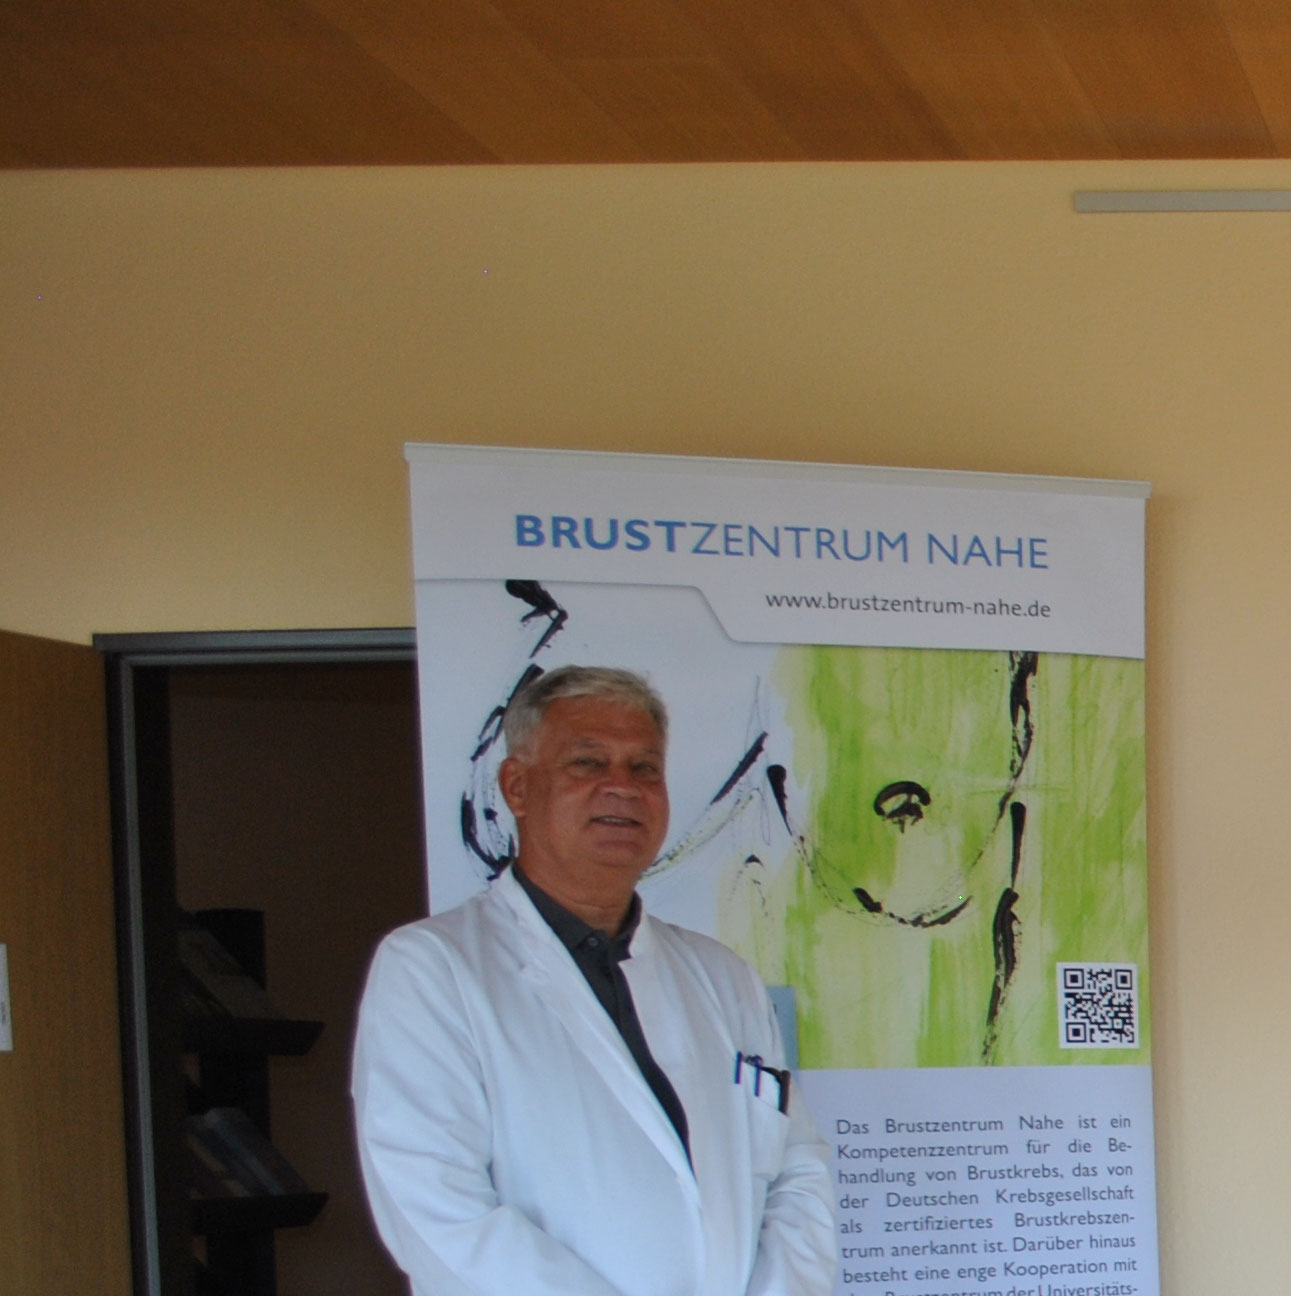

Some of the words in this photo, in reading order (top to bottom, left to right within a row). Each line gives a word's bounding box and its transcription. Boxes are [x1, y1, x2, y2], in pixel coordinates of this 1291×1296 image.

[515, 514, 909, 563] BRUSTZENTRUM
[928, 536, 1050, 570] NAHE
[766, 591, 1052, 618] www.brustzentrum-nahe.de
[836, 1119, 870, 1135] Das
[885, 1118, 1004, 1134] Brustzentrum
[1019, 1116, 1064, 1131] Nahe
[1078, 1115, 1097, 1130] ist
[1111, 1115, 1131, 1128] ein
[838, 1142, 1009, 1163] Kompetenzzentrum
[1027, 1139, 1051, 1154] für
[1068, 1138, 1092, 1153] die
[1108, 1138, 1132, 1152] Be-
[838, 1168, 916, 1188] handlung
[926, 1168, 957, 1182] von
[968, 1164, 1064, 1182] Brustkrebs,
[1072, 1163, 1098, 1177] das
[1108, 1164, 1133, 1176] von
[840, 1194, 869, 1209] der
[886, 1191, 979, 1209] Deutschen
[996, 1186, 1135, 1208] Krebsgesellschaft
[841, 1219, 863, 1234] als
[884, 1214, 993, 1233] zertifiziertes
[1015, 1211, 1135, 1228] Brustkrebszen-
[842, 1243, 885, 1258] trum
[891, 1240, 978, 1257] anerkannt
[984, 1238, 1009, 1254] ist.
[1013, 1235, 1084, 1252] Darüber
[1089, 1234, 1136, 1249] hinaus
[843, 1266, 908, 1284] besteht
[915, 1265, 951, 1281] eine
[957, 1266, 997, 1282] enge
[1004, 1259, 1108, 1280] Kooperation
[1114, 1258, 1138, 1273] mit
